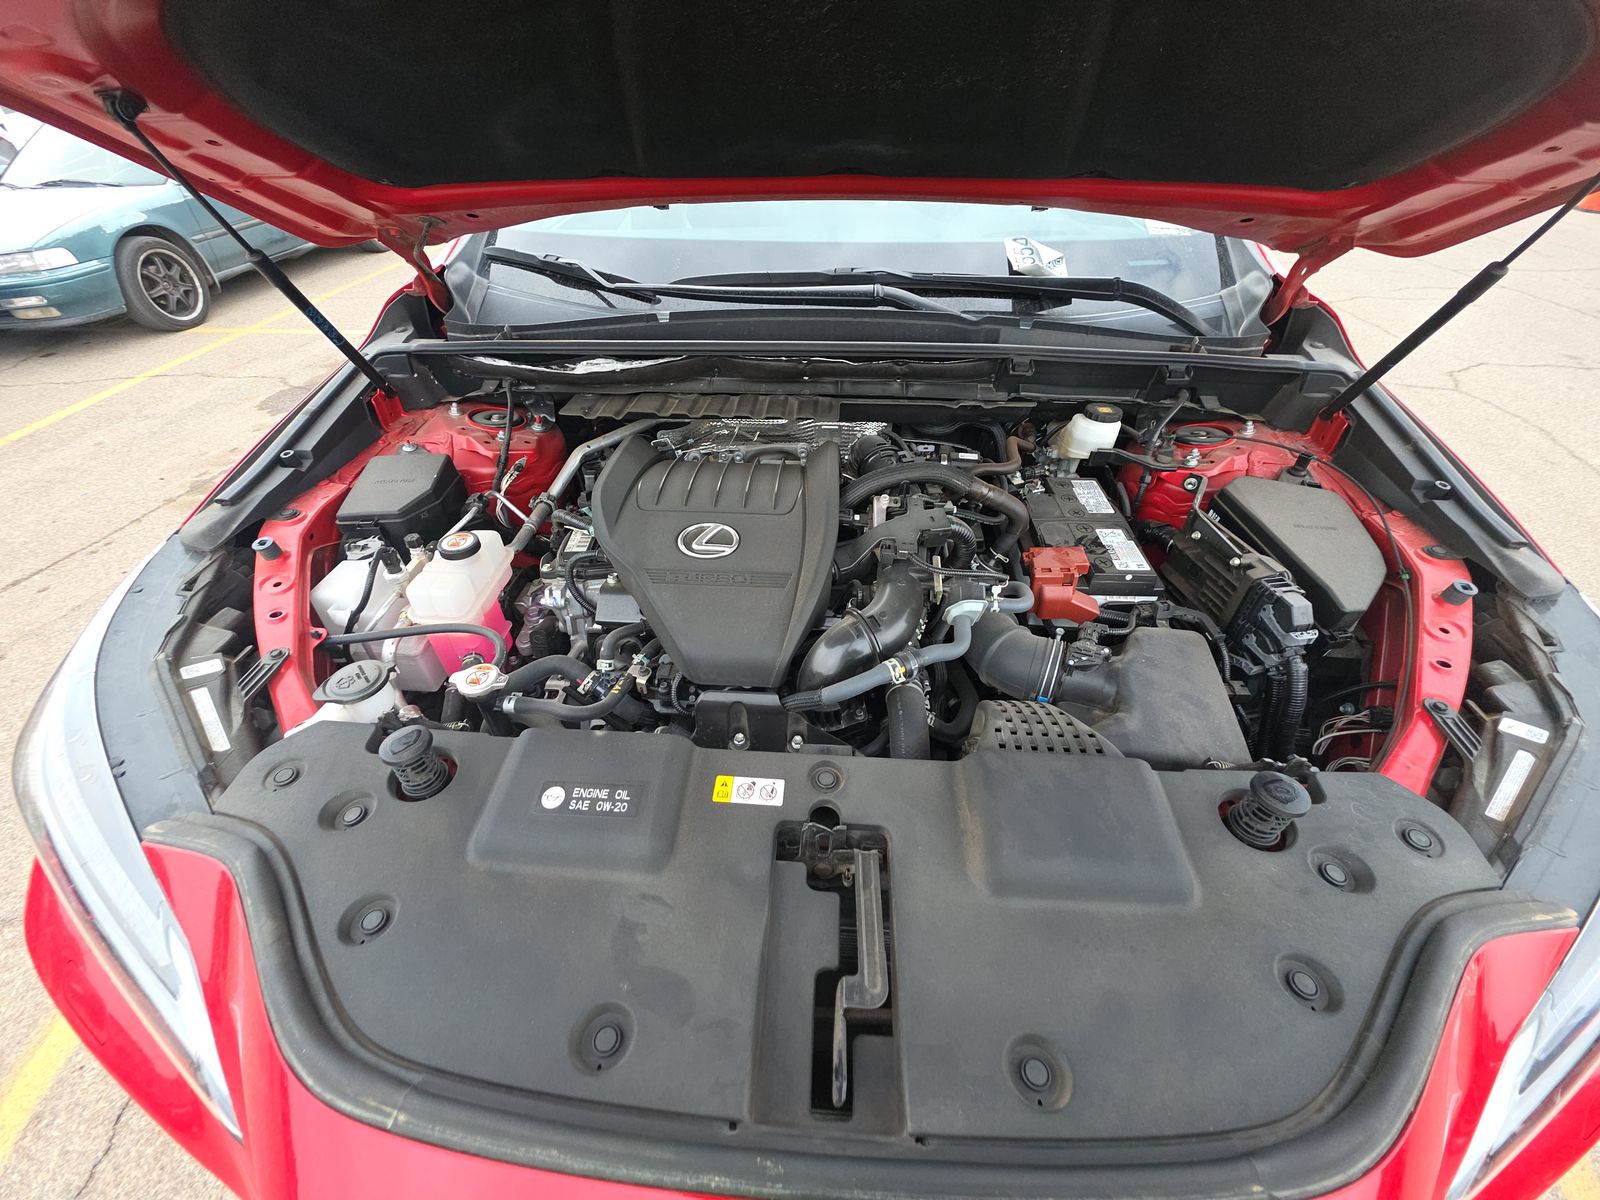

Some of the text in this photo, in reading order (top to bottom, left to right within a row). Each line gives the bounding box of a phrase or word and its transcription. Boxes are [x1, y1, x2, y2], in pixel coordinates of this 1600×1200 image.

[671, 571, 750, 585] TURBO
[572, 788, 630, 800] ENGINE OIL
[569, 800, 628, 812] SAE 0W-20
